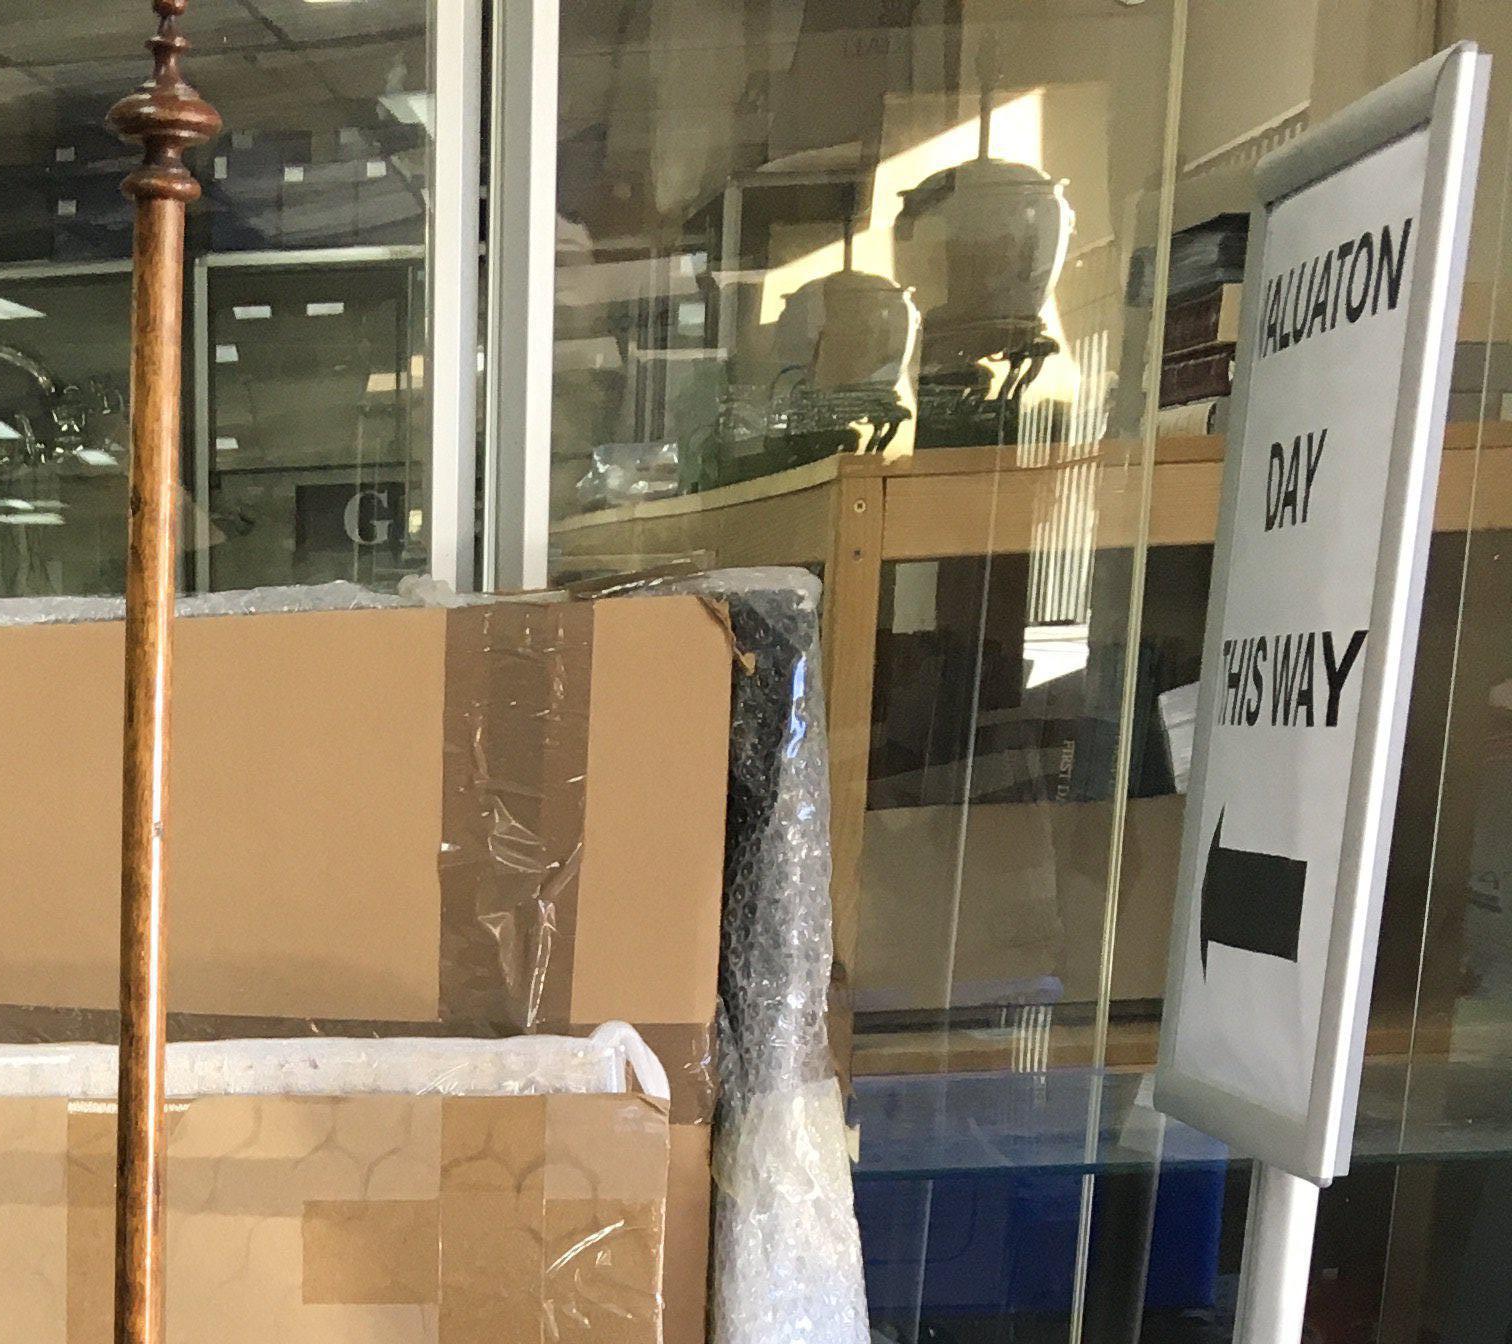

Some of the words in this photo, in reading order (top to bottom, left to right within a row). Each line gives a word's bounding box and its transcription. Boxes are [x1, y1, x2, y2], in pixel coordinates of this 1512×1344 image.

[1264, 428, 1328, 532] DAY
[1218, 636, 1268, 727] THIS
[1271, 629, 1369, 728] WAY
